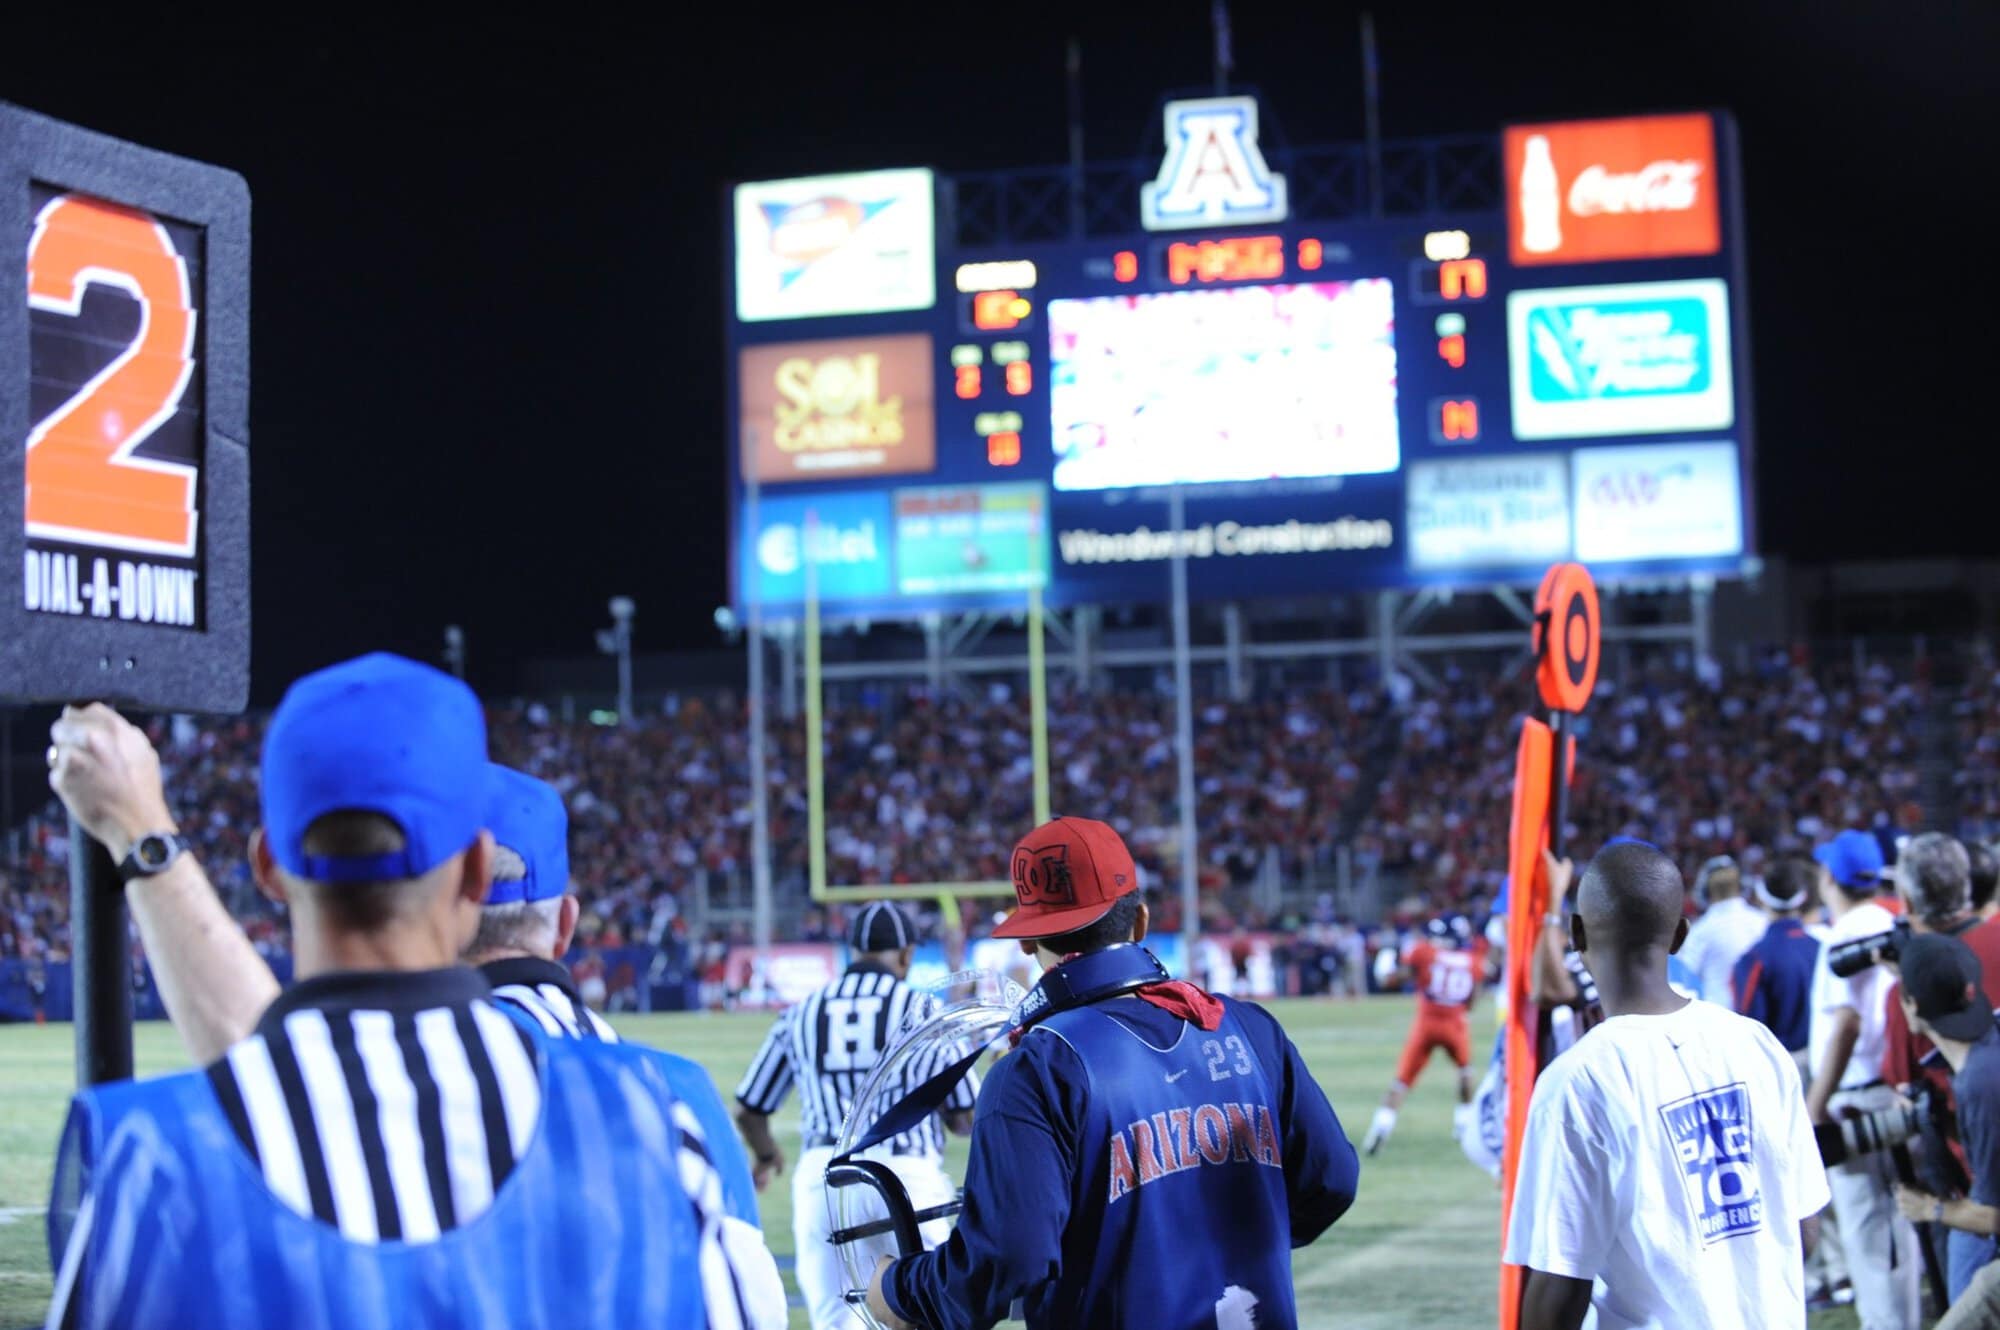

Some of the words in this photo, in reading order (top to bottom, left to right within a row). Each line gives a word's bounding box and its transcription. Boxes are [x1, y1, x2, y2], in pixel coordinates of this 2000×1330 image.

[1140, 96, 1288, 231] A
[25, 192, 198, 558] 2
[24, 549, 196, 627] DIAL-A-DOWN
[823, 996, 882, 1070] H
[1202, 1034, 1252, 1082] 23
[1109, 1103, 1282, 1203] ARIZONA
